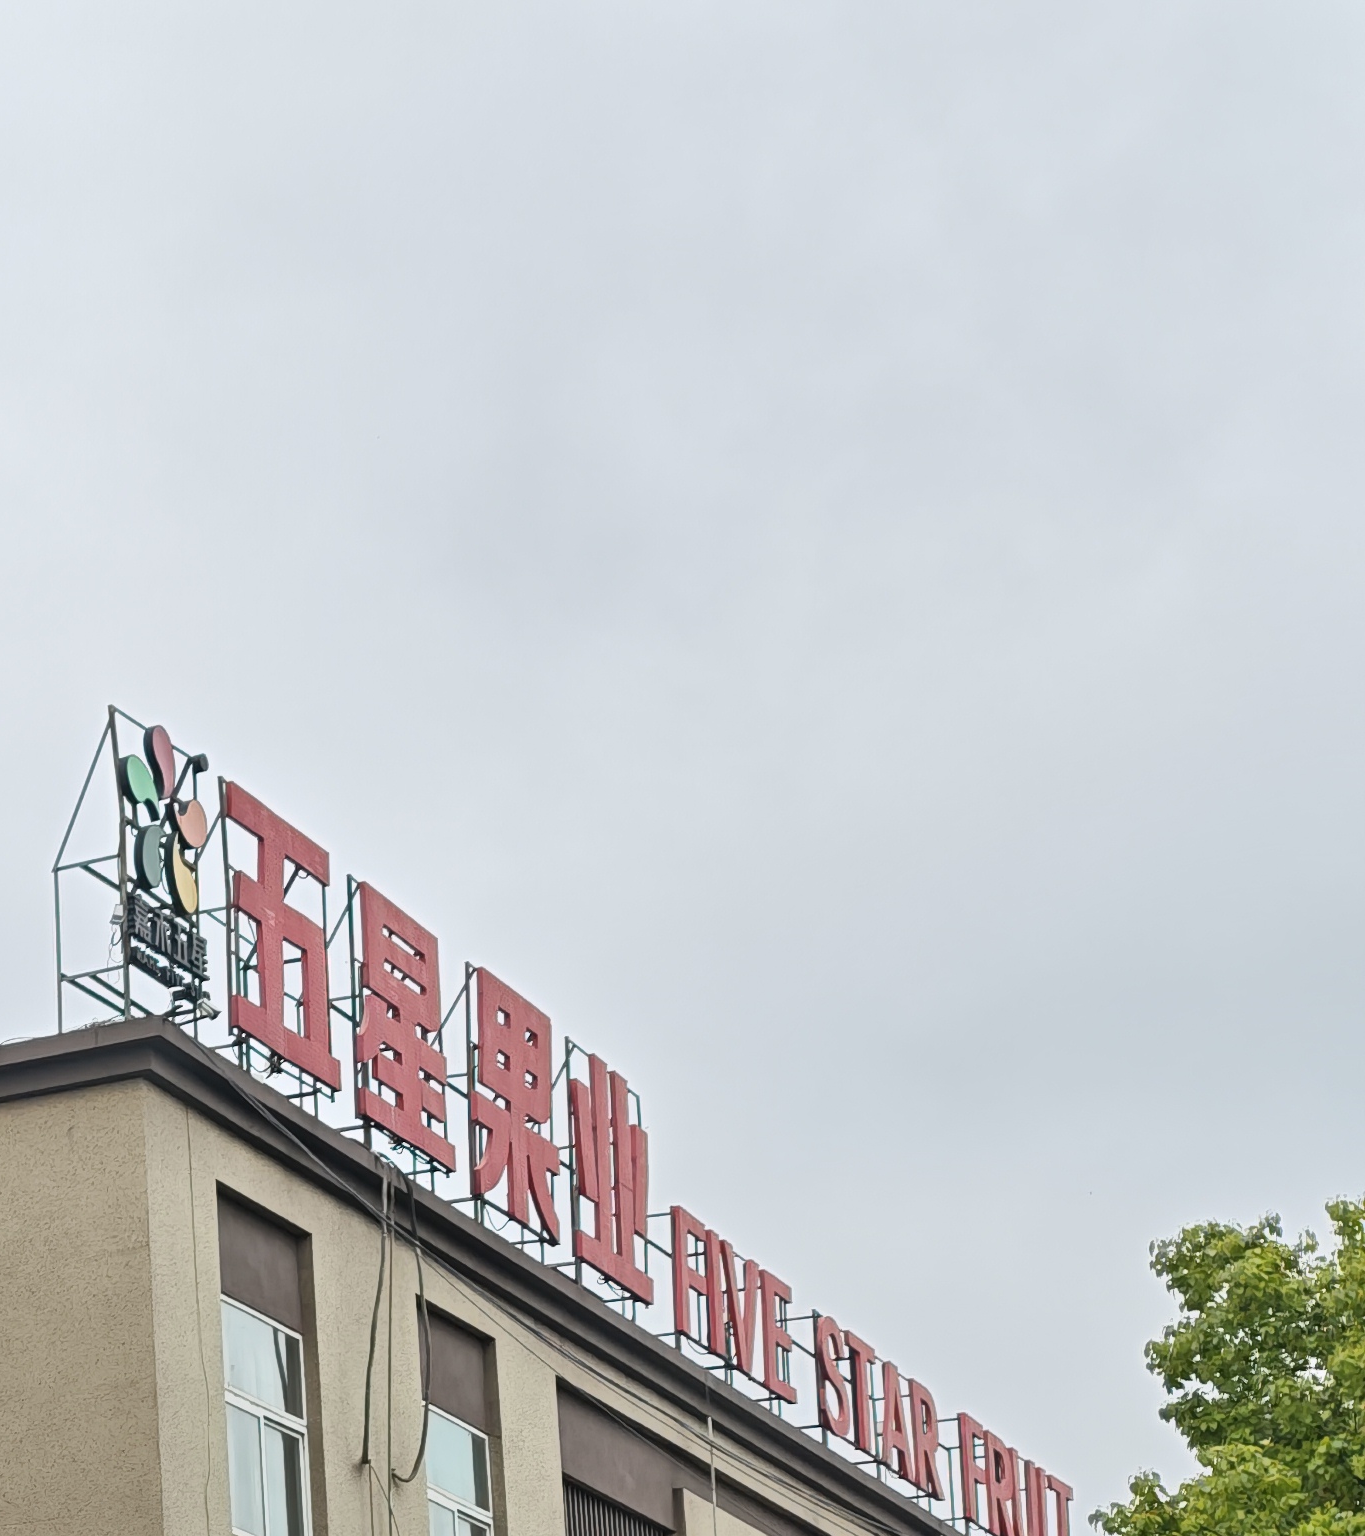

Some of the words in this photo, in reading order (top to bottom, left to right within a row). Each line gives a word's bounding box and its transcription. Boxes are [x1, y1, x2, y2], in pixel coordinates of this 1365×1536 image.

[225, 781, 654, 1305] 五星果业
[670, 1205, 797, 1404] FIVE
[815, 1315, 945, 1501] STAR
